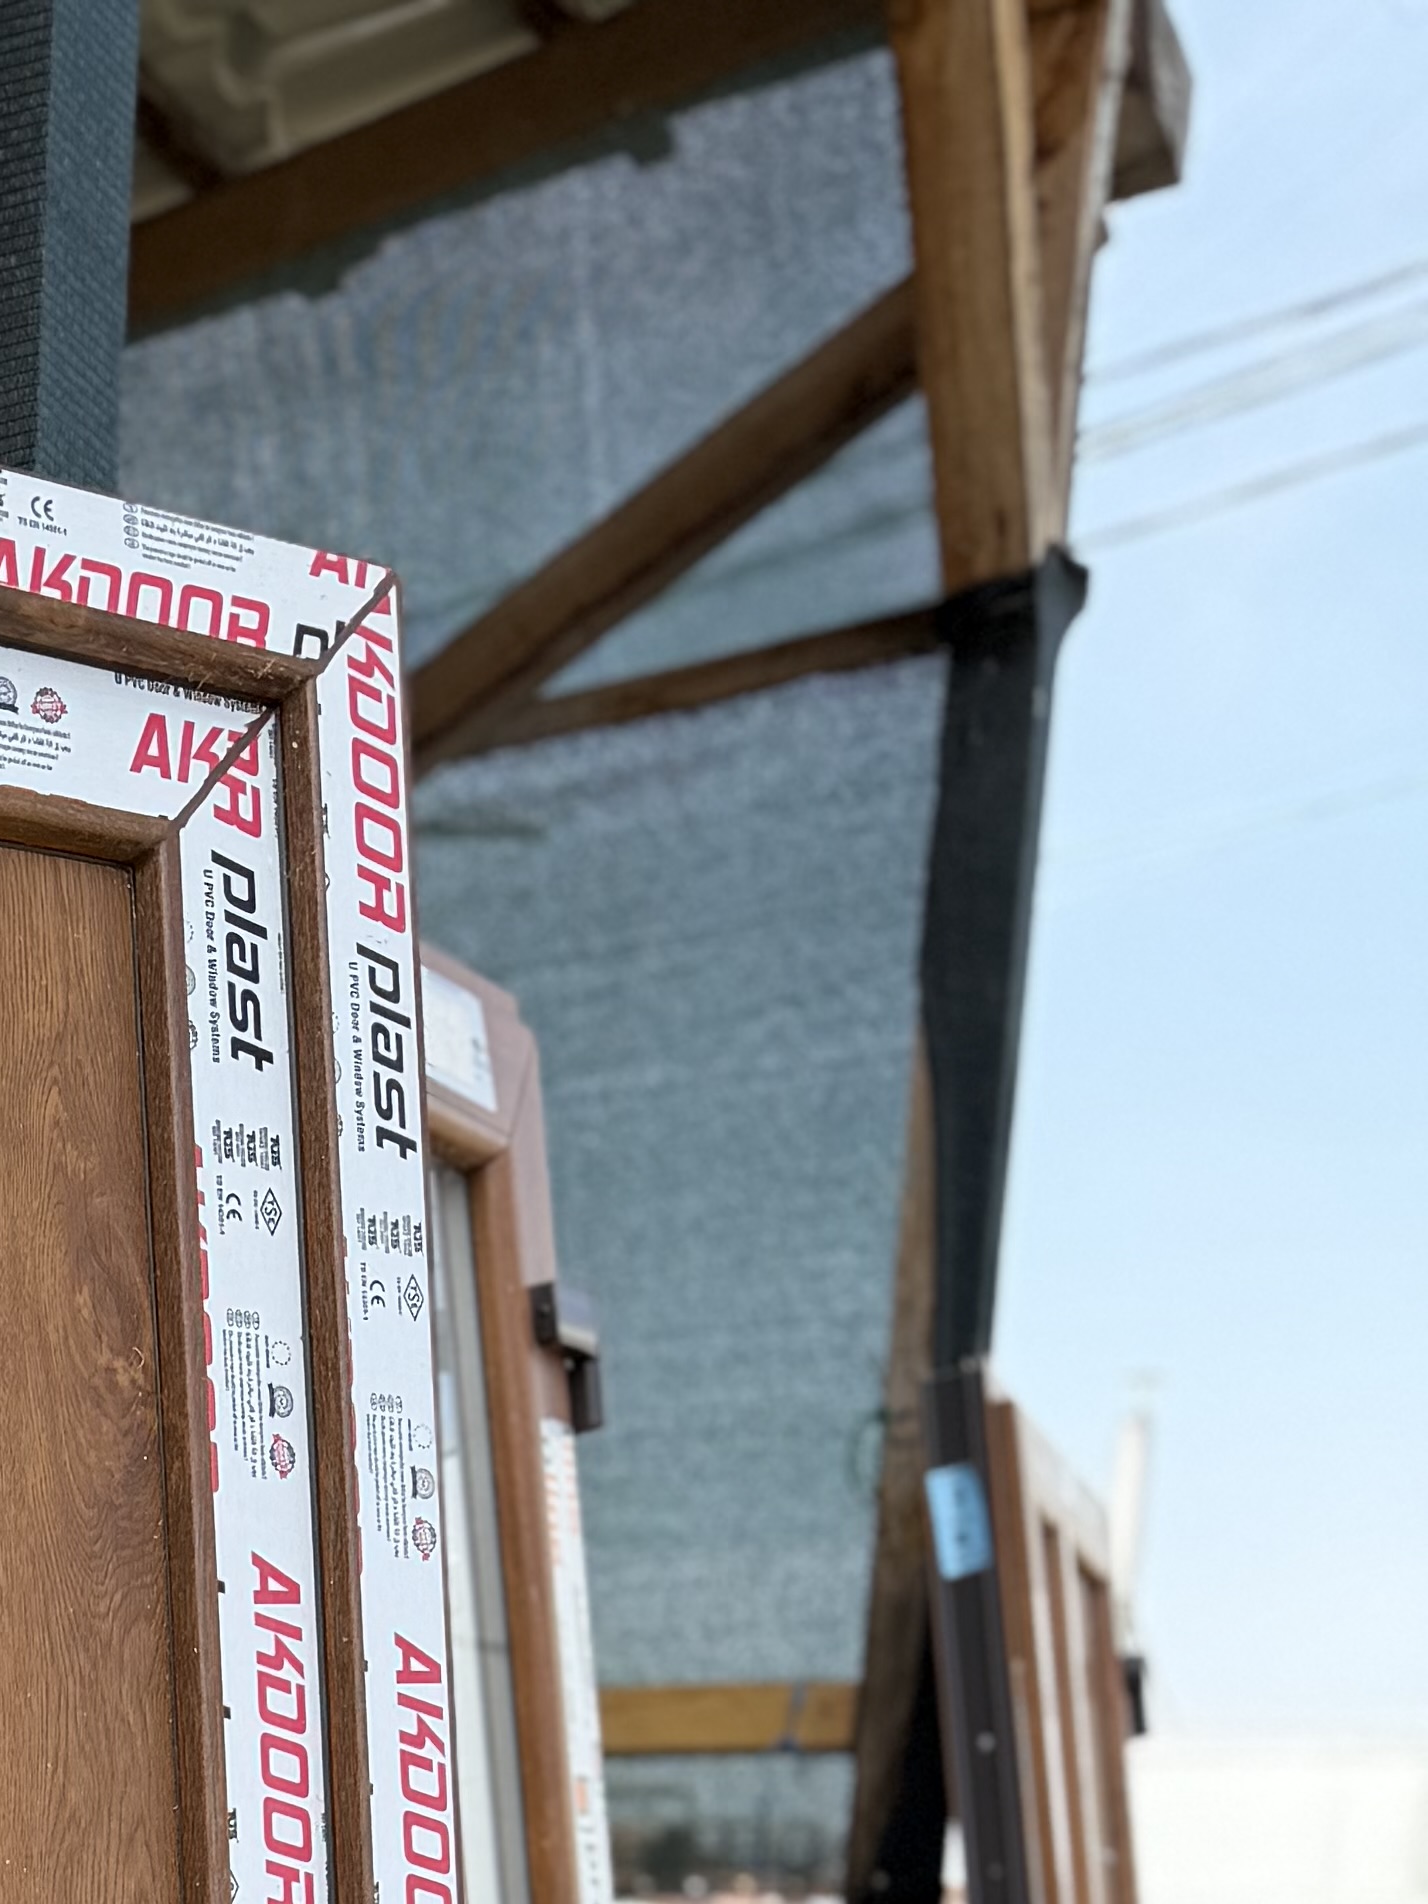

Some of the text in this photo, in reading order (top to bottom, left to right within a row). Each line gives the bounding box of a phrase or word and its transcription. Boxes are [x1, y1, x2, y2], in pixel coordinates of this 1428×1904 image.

[212, 850, 273, 1071] plast
[346, 594, 417, 1160] KDOOR plast
